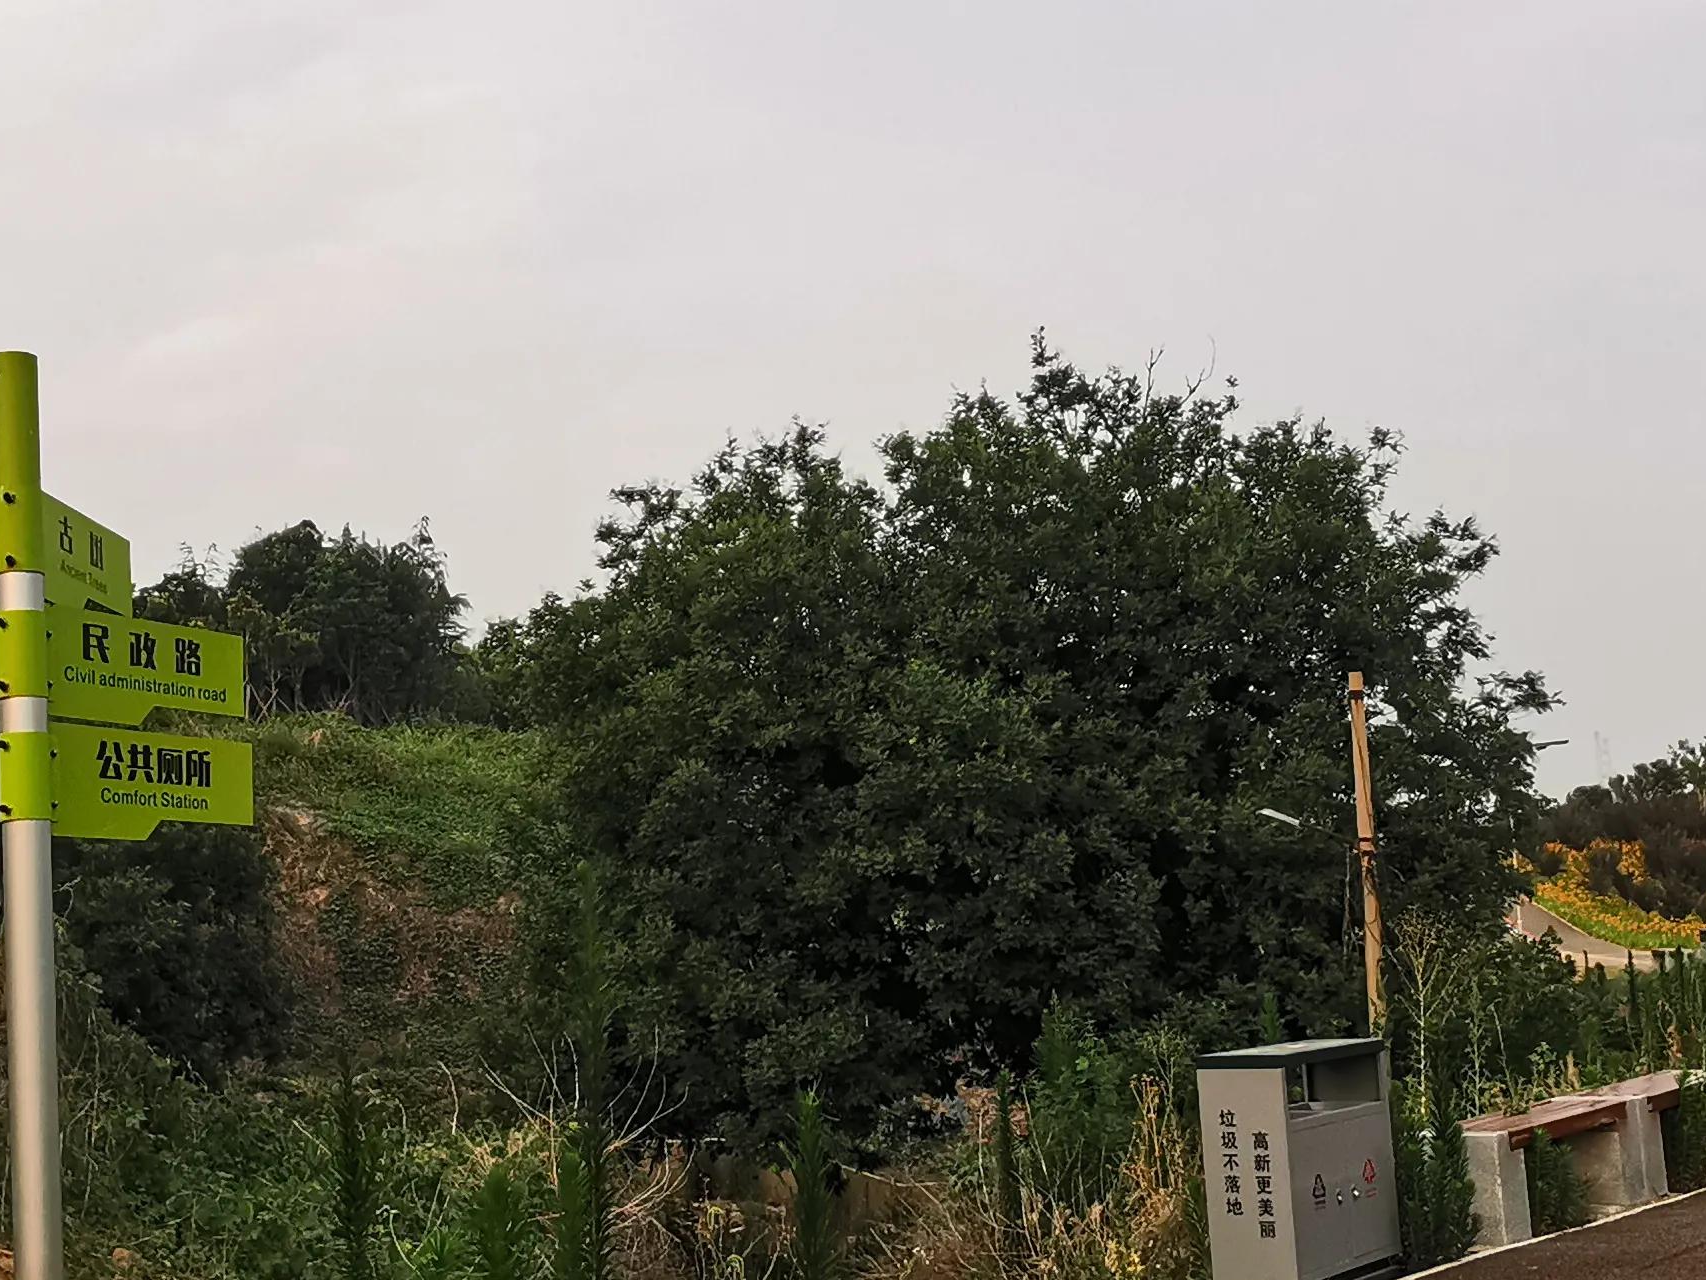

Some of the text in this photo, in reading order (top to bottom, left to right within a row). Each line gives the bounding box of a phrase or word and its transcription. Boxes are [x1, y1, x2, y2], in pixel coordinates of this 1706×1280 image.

[82, 623, 201, 677] 民政路
[64, 665, 227, 703] Civil administration road
[96, 740, 211, 788] 公共厕所
[100, 787, 209, 810] Comfort Station
[1219, 1109, 1244, 1216] 垃圾不落地
[1251, 1131, 1277, 1239] 高新更美丽
